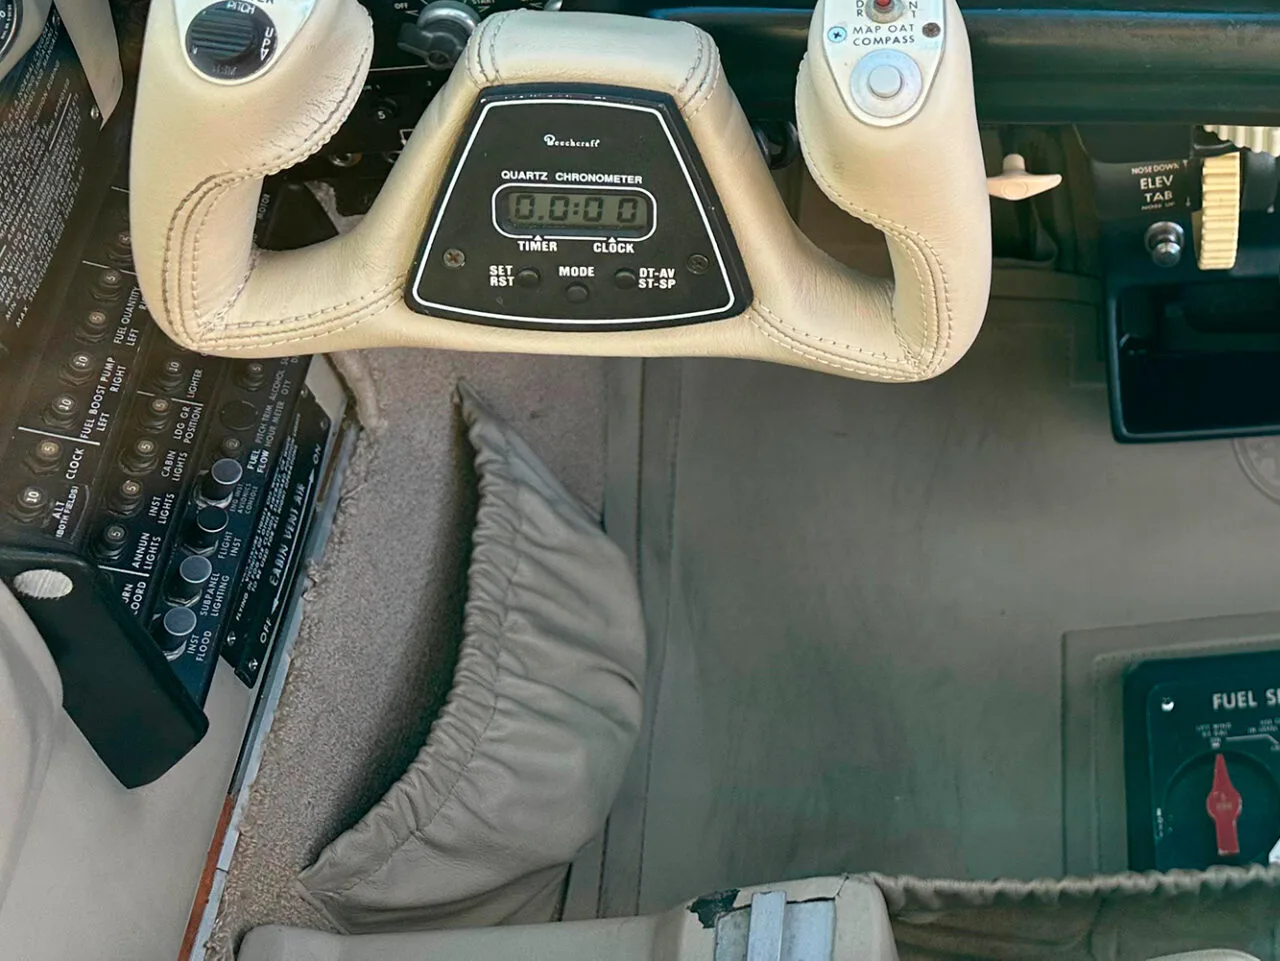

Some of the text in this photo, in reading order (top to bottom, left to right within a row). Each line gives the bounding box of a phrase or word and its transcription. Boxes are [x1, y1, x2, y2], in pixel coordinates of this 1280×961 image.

[227, 1, 255, 14] PITCH
[853, 24, 915, 34] MAP OAT
[853, 35, 915, 46] COMPASS
[544, 134, 600, 148] Beechcraft
[501, 170, 642, 184] QUARTZ CHRONOMETER
[1139, 175, 1174, 189] ELEV
[1144, 190, 1173, 203] TAB
[517, 241, 557, 252] TIMER
[593, 242, 634, 253] CLOCK
[489, 266, 513, 276] SET
[559, 266, 595, 277] MODE
[638, 268, 675, 278] DT-AV
[490, 277, 514, 286] RST
[638, 278, 676, 288] ST-SP
[114, 287, 140, 344] FUEL QUANTITY
[126, 329, 139, 346] LEFT
[110, 365, 126, 392] RIGHT
[80, 357, 115, 440] FUEL BOOST PUMP
[96, 412, 110, 432] LEFT
[66, 447, 84, 480] CLOCK
[161, 450, 176, 477] CABIN
[172, 452, 188, 481] LIGHTS
[201, 572, 220, 616] SUBPANEL
[211, 575, 229, 617] LIGHTING
[187, 634, 200, 654] INST
[196, 630, 212, 662] FLOOD
[1212, 691, 1257, 711] FUEL
